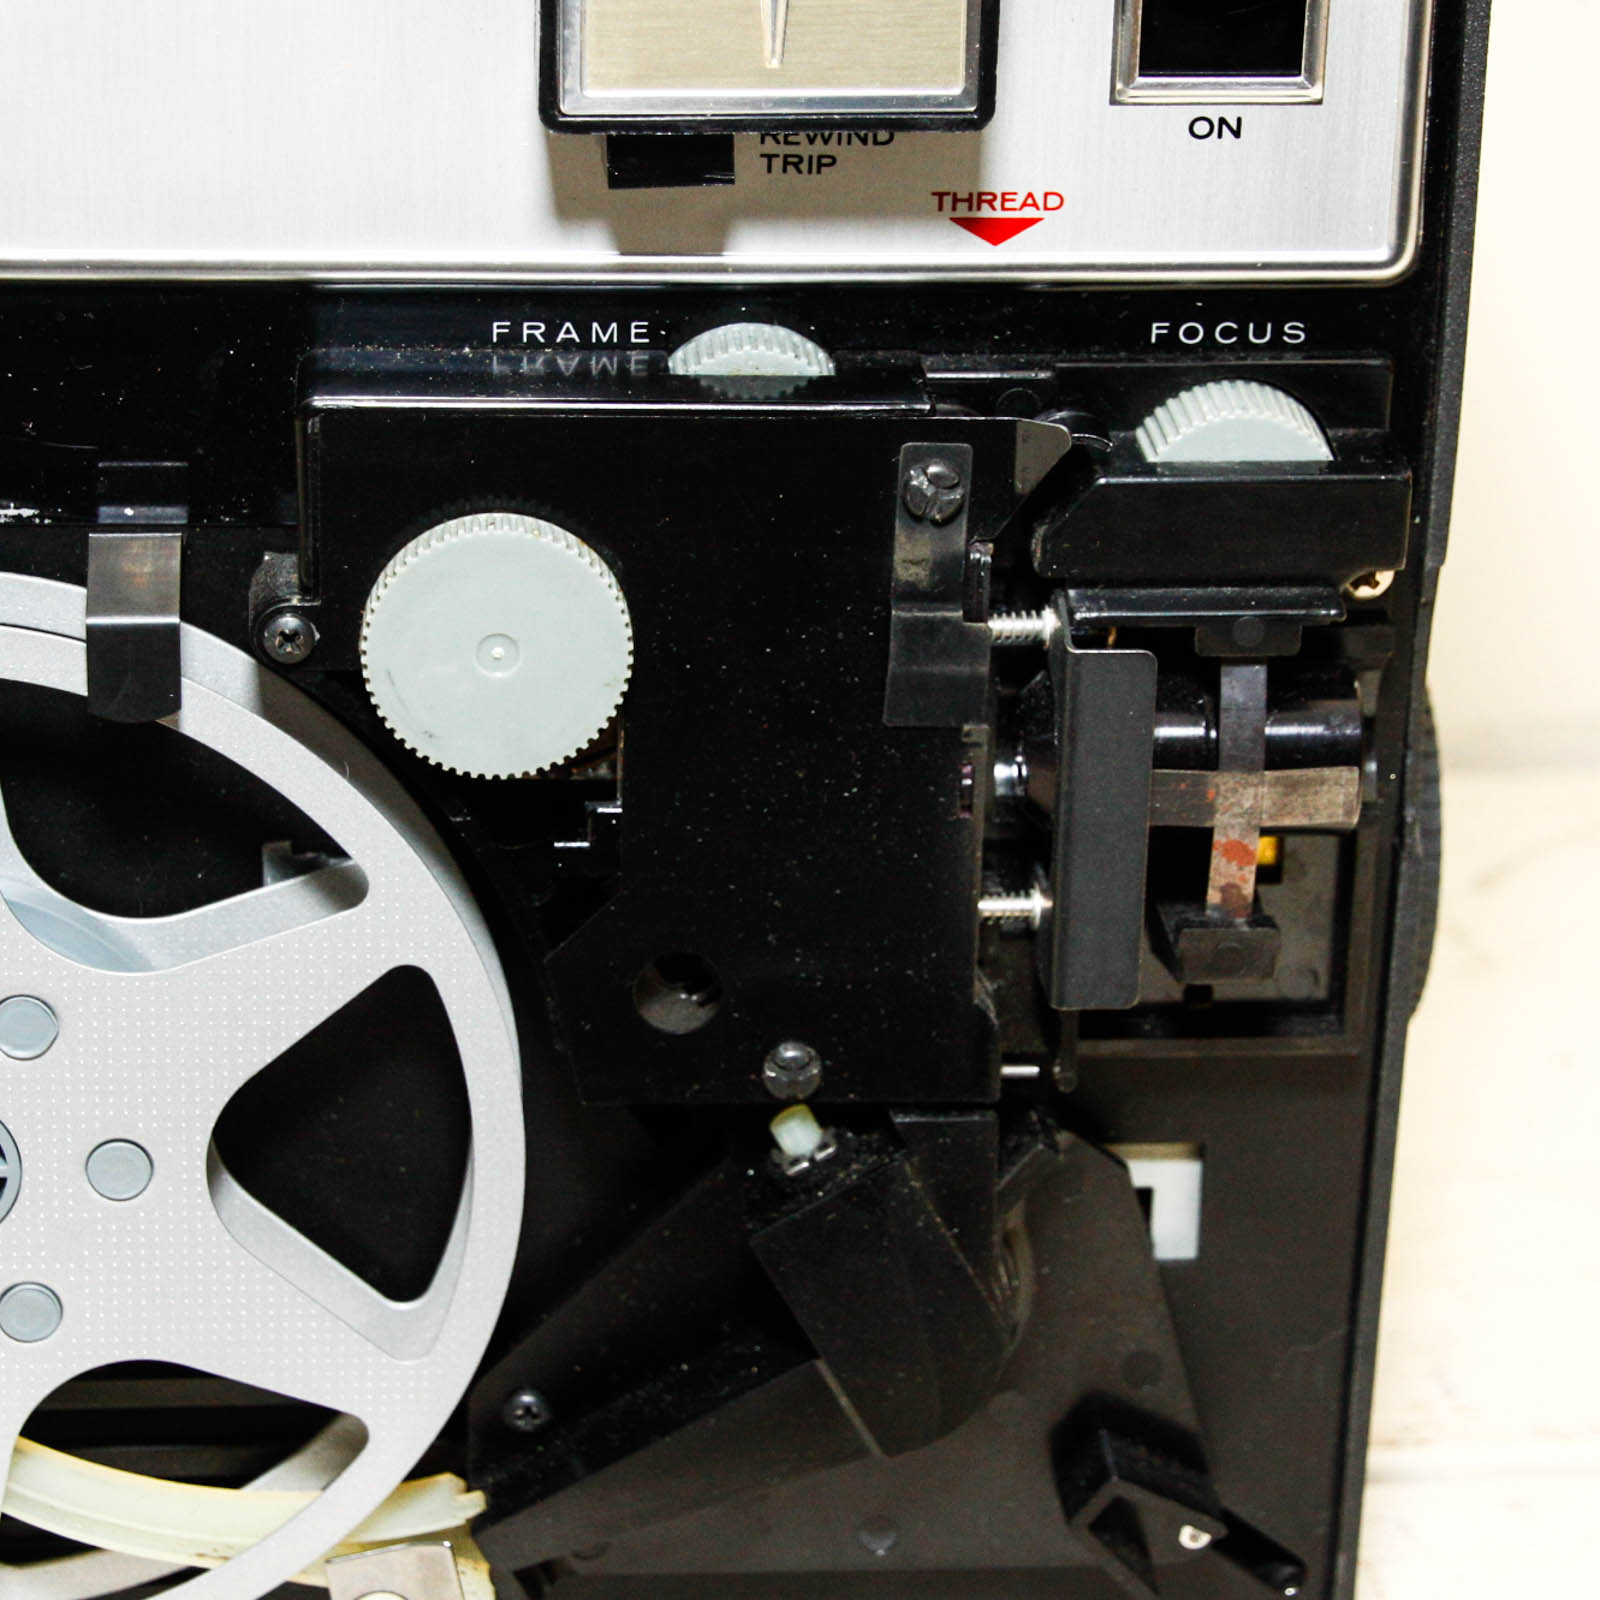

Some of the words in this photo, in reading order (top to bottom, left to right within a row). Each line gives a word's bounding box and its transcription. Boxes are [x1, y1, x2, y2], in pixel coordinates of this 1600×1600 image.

[760, 132, 895, 146] REWIND
[1188, 116, 1242, 140] ON
[760, 153, 837, 175] TRIP
[931, 191, 1065, 212] THREAD
[492, 321, 650, 343] FRAME
[1150, 321, 1306, 344] FOCUS
